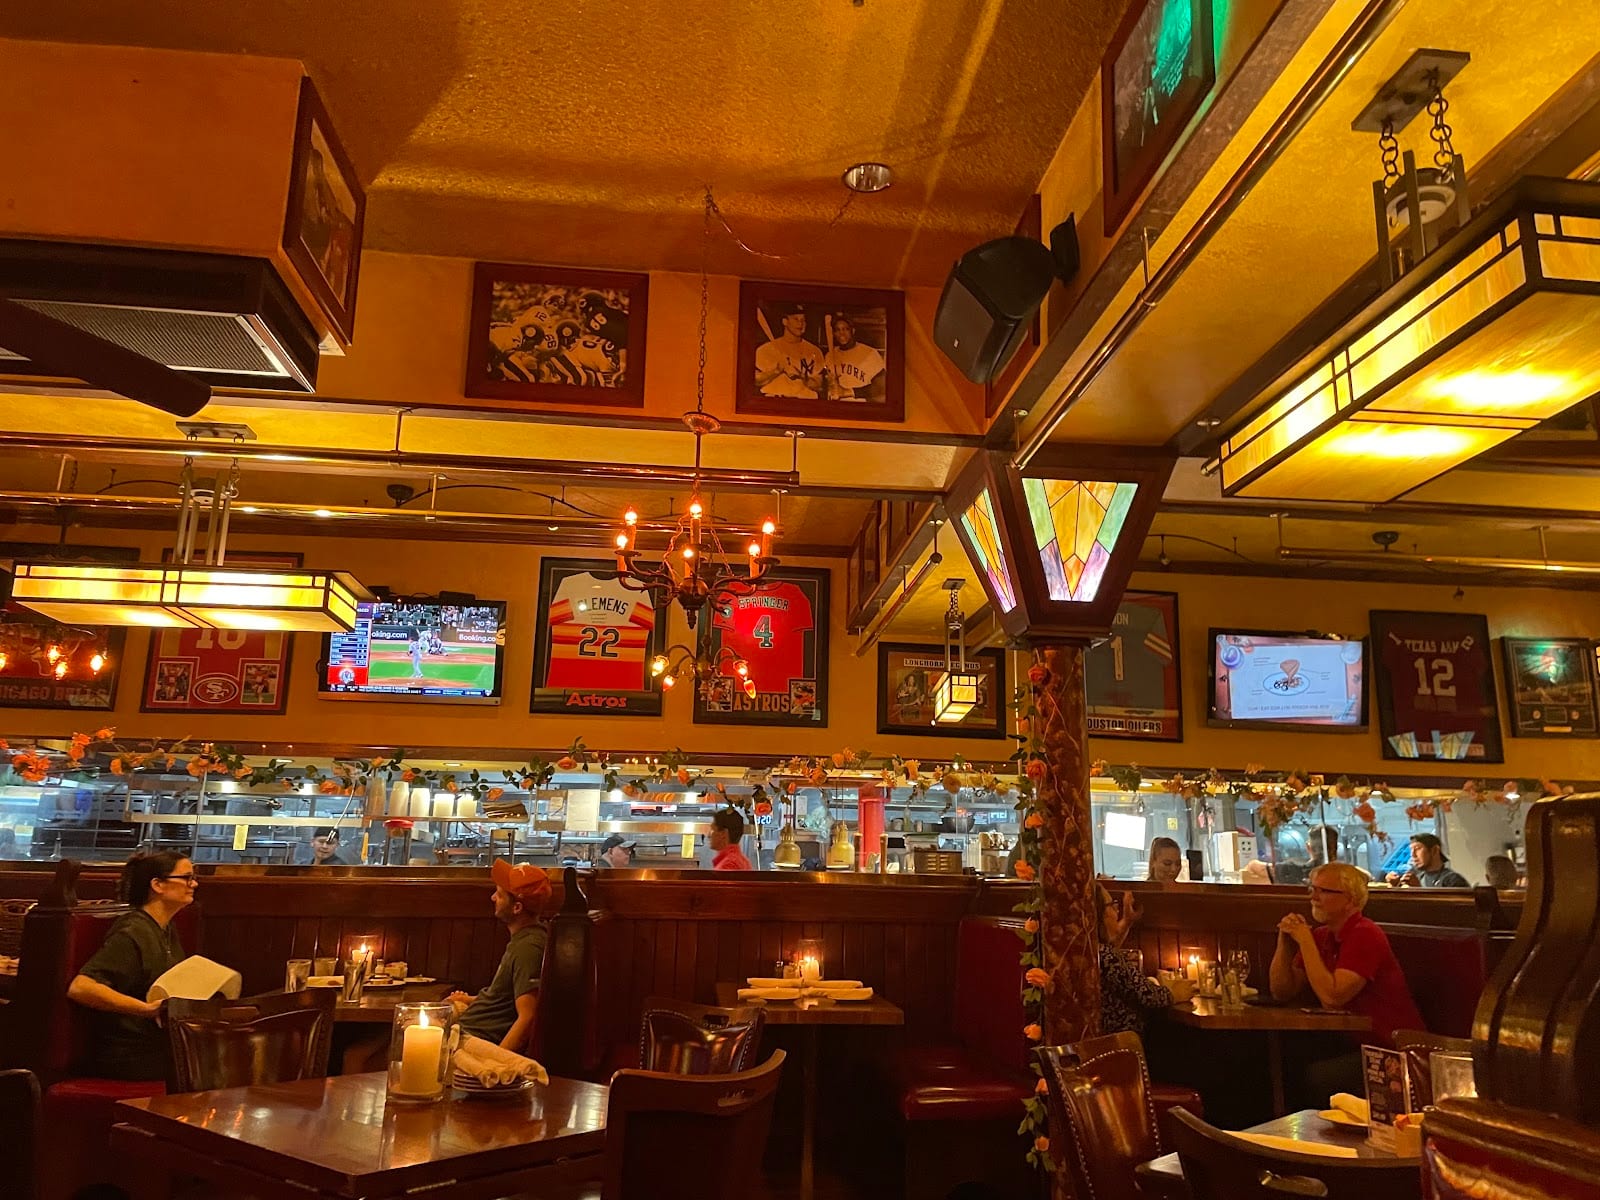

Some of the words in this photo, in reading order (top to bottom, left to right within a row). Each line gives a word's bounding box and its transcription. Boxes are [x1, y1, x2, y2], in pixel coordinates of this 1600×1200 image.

[840, 363, 866, 382] YORK
[738, 596, 789, 611] SPRINGER
[371, 630, 408, 640] oking.com
[458, 633, 496, 643] Booking.co
[753, 614, 774, 649] 4
[578, 626, 620, 658] 22
[1403, 639, 1437, 653] TEXAS
[904, 658, 945, 668] LONGHORN
[1110, 635, 1124, 681] 1
[1414, 657, 1457, 697] 12
[0, 684, 51, 700] ICAGO
[565, 691, 627, 709] Astros
[733, 693, 790, 713] ASTROS
[1087, 717, 1125, 731] OUSTON
[1128, 719, 1162, 734] OILERS
